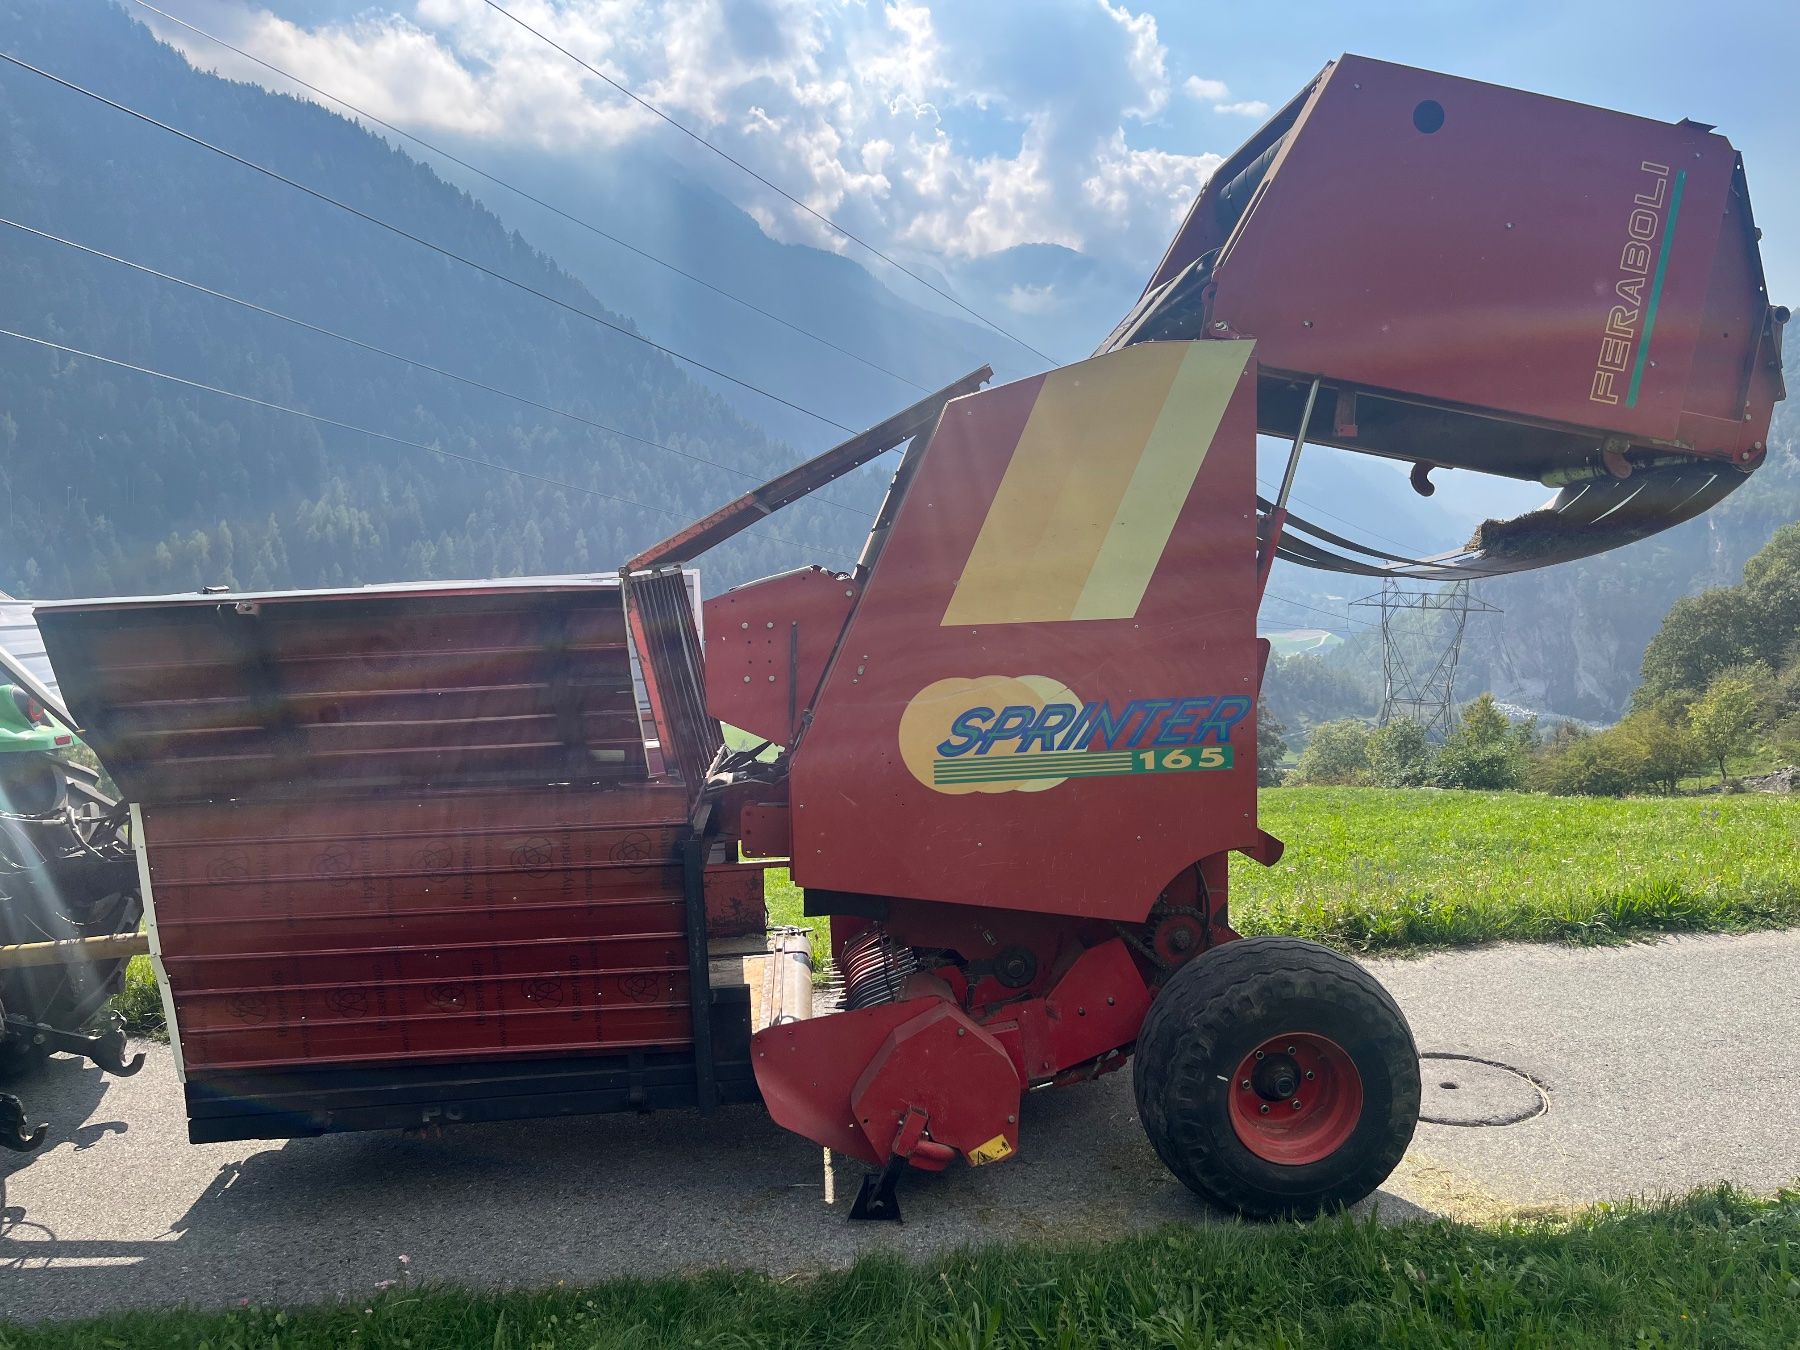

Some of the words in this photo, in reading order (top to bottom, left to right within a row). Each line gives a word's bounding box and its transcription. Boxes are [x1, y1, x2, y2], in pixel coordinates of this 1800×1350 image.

[1590, 161, 1669, 404] FERABOLI
[936, 695, 1252, 757] SPRINTER
[1139, 747, 1225, 770] 165
